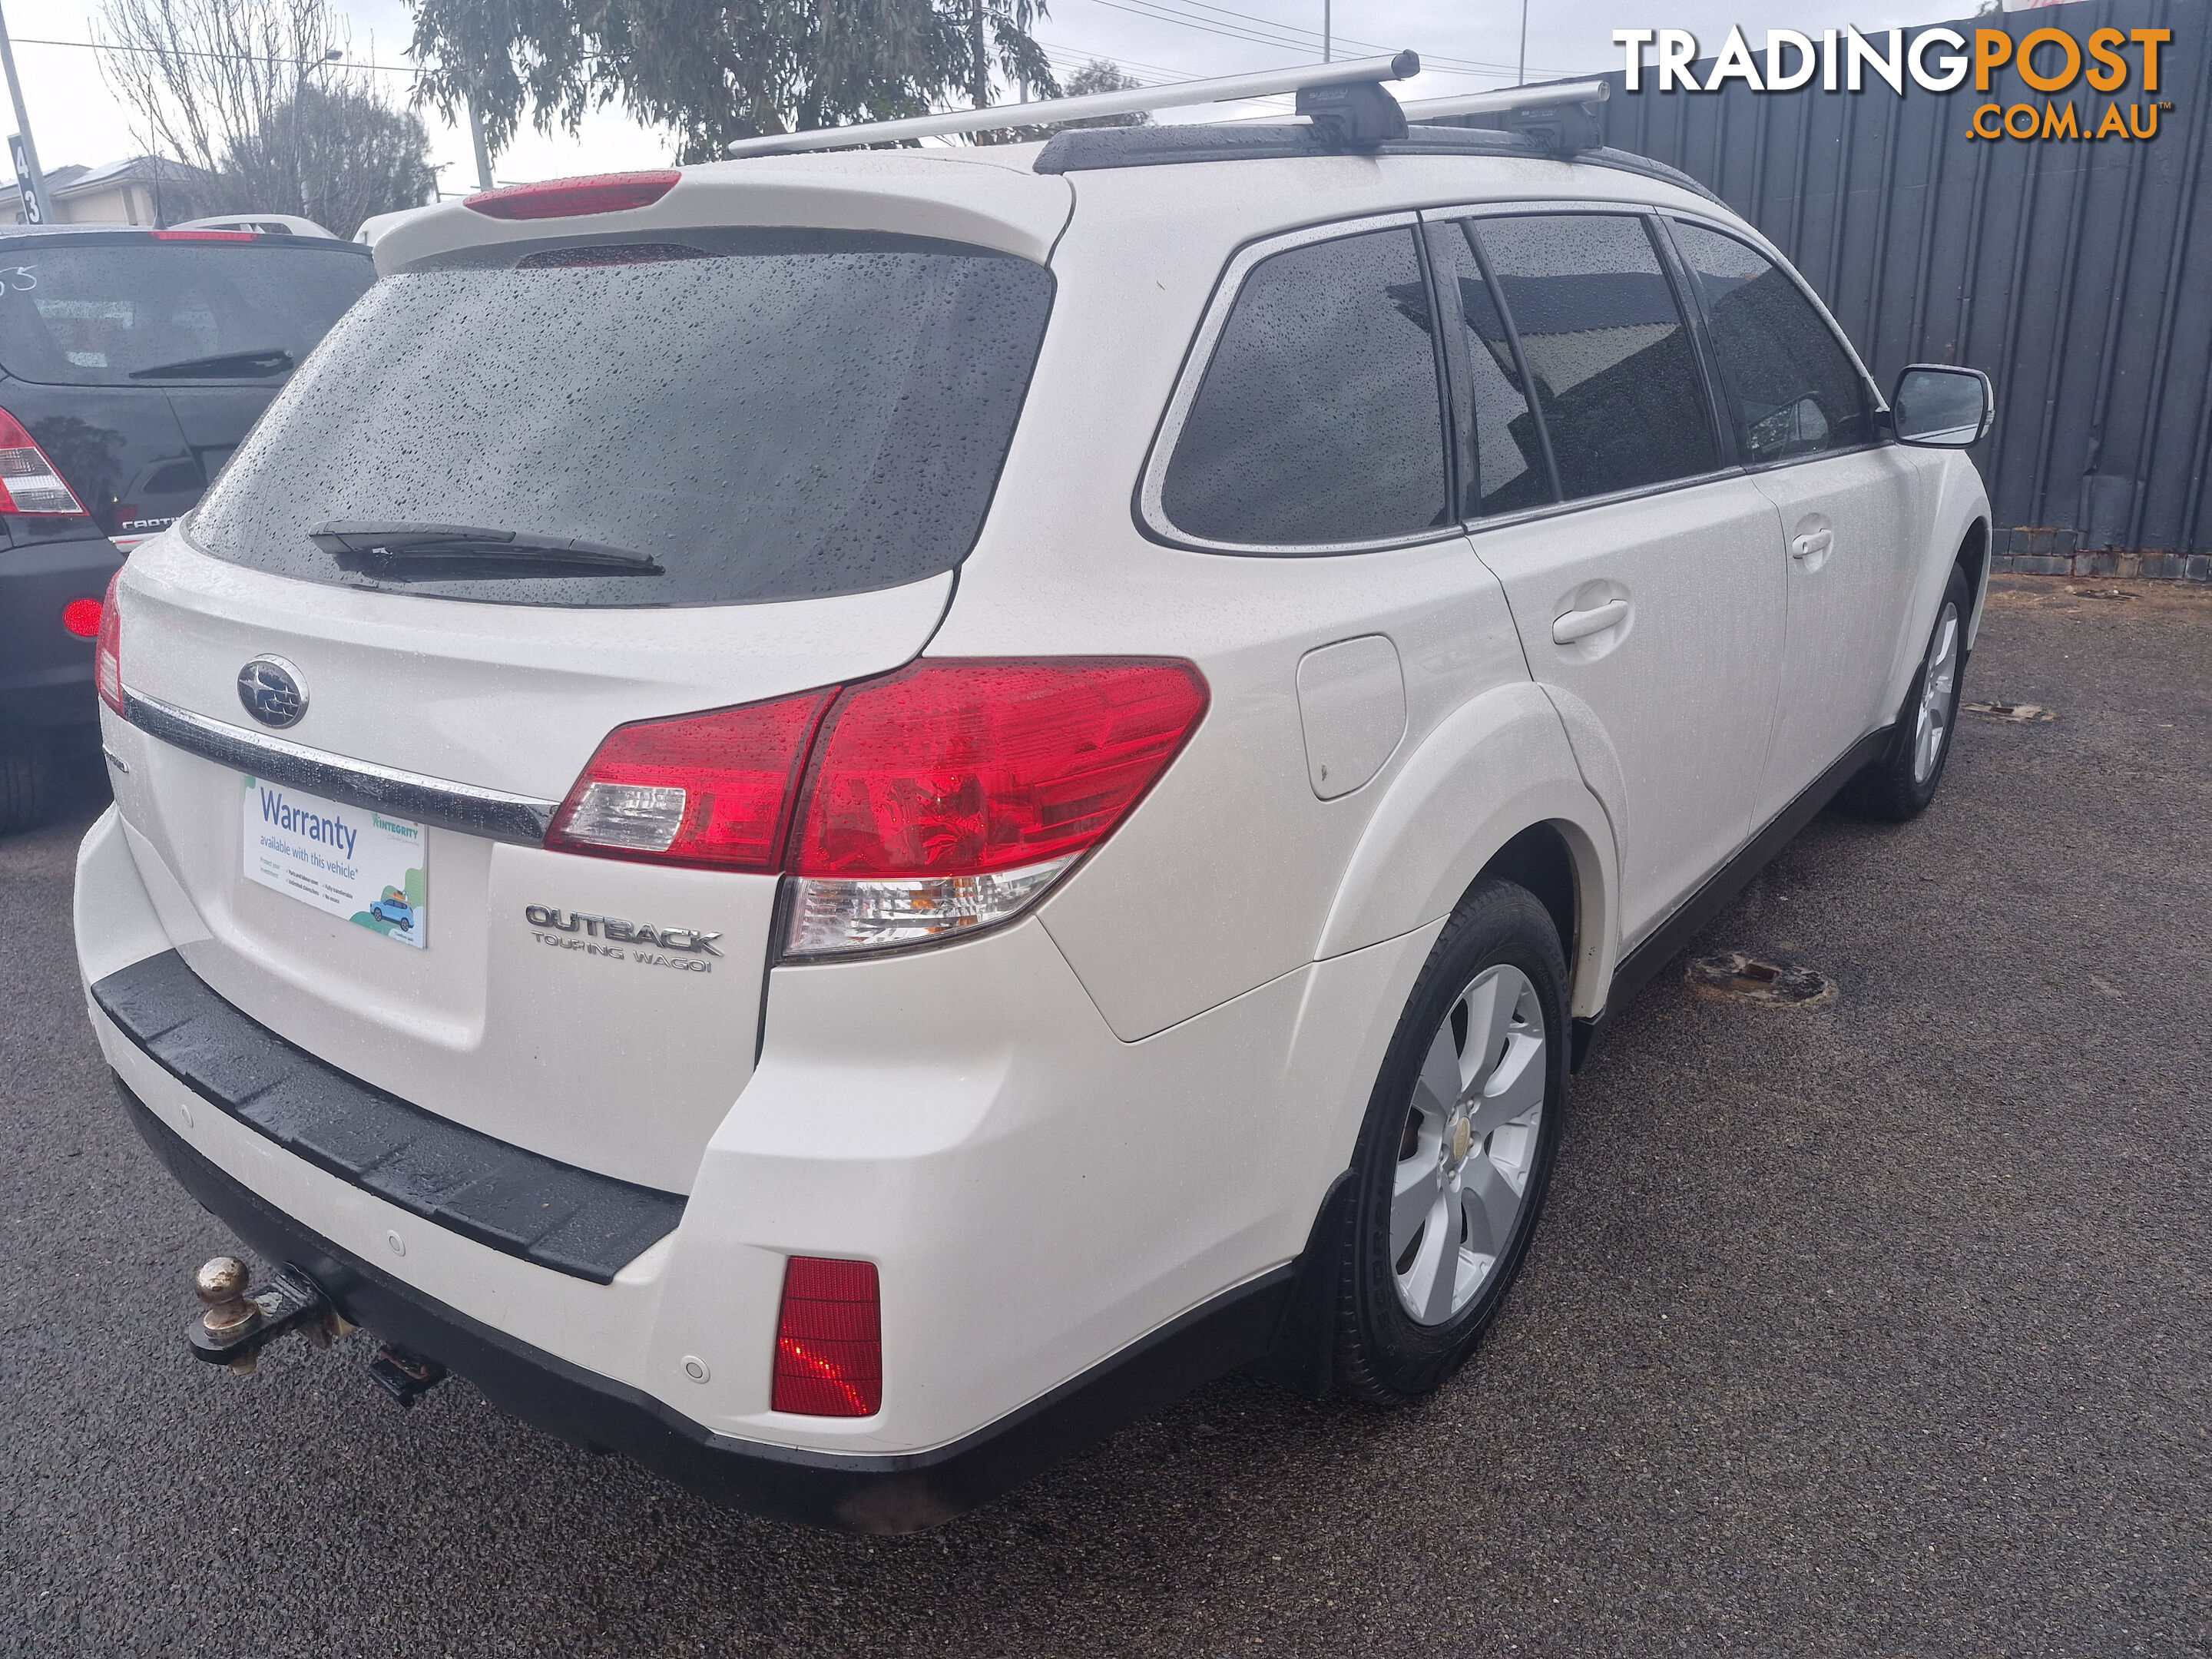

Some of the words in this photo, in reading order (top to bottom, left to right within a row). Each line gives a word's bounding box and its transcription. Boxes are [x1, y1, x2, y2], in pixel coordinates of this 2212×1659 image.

[260, 786, 357, 859] Warranty
[379, 819, 419, 839] INTEGRITY
[260, 835, 291, 856] available
[292, 846, 309, 863] with
[310, 852, 325, 869] this
[525, 903, 724, 958] OUTBACK
[531, 930, 624, 959] TOURING
